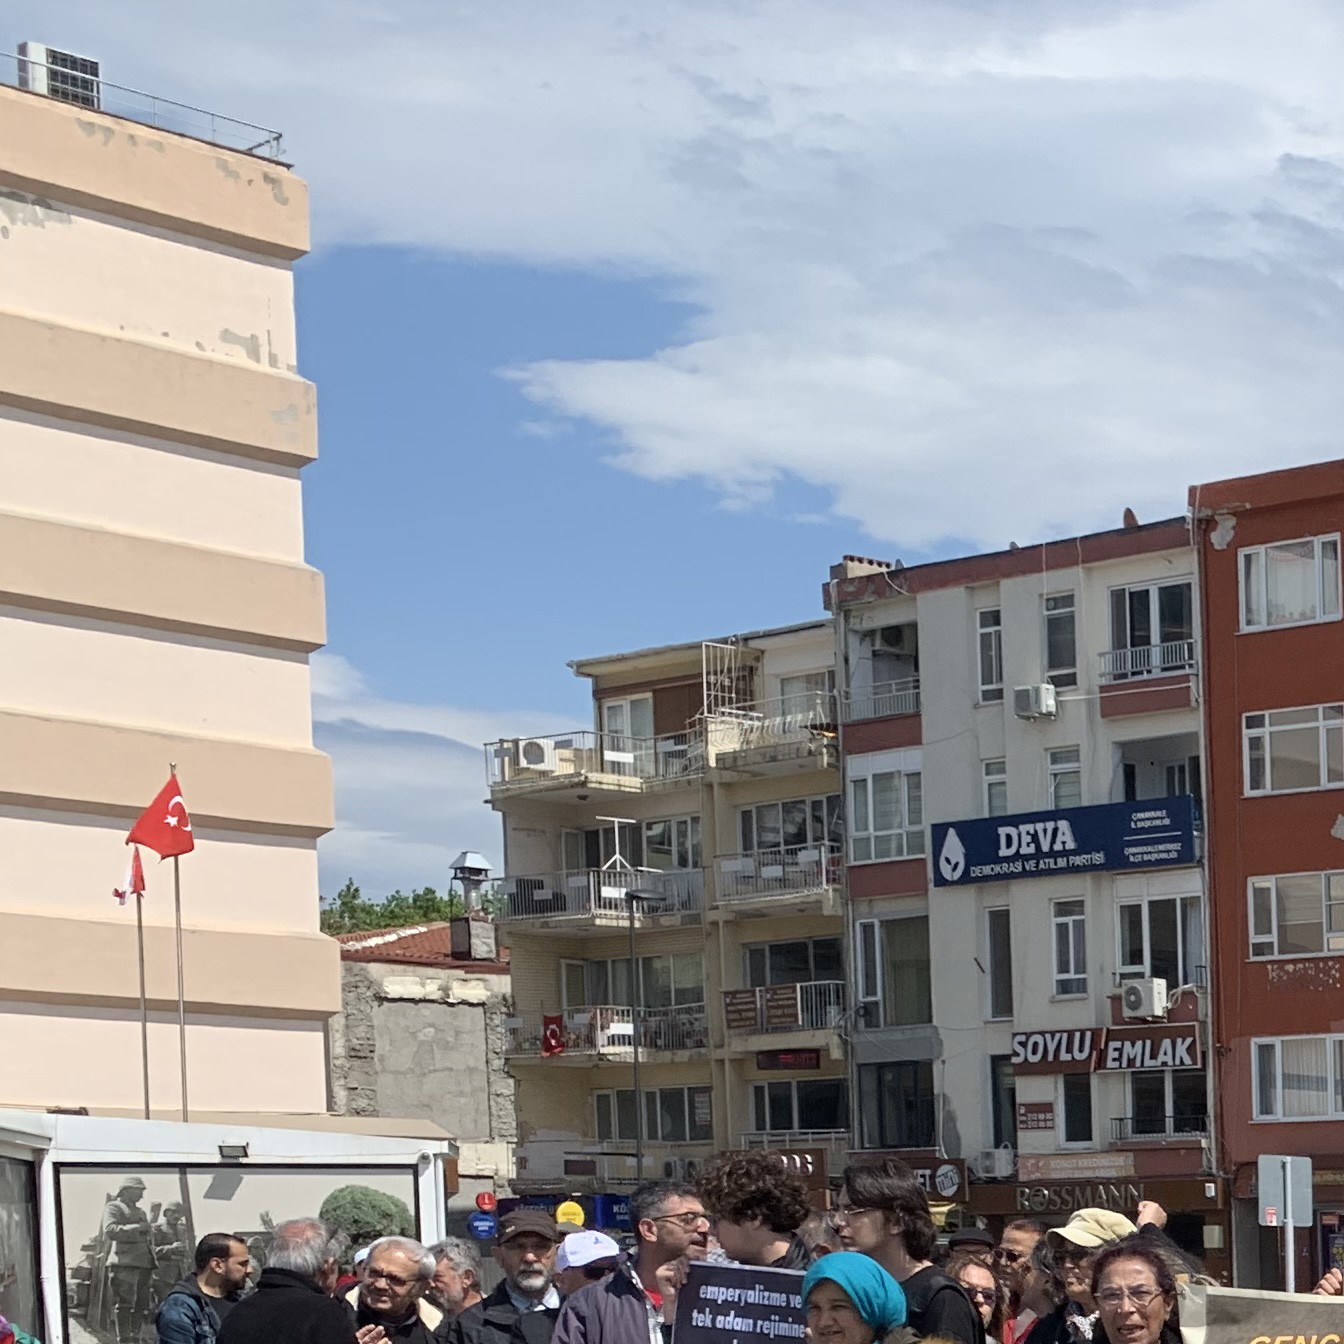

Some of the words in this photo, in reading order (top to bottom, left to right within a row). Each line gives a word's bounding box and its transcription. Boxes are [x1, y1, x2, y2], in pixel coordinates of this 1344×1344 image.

[997, 819, 1077, 857] DEVA
[969, 859, 1023, 877] DEMOKRASİ
[1024, 859, 1037, 872] VE
[1039, 857, 1068, 871] ATILIM
[1069, 852, 1106, 867] PARTİSİ
[1011, 1030, 1092, 1064] SOYLU
[1106, 1036, 1194, 1069] EMLAK
[1016, 1184, 1145, 1211] ROSSMANN
[699, 1283, 788, 1307] emperyalizme
[789, 1294, 803, 1309] ve
[692, 1308, 713, 1328] tek
[715, 1310, 753, 1332] adam
[756, 1315, 806, 1339] rejimine
